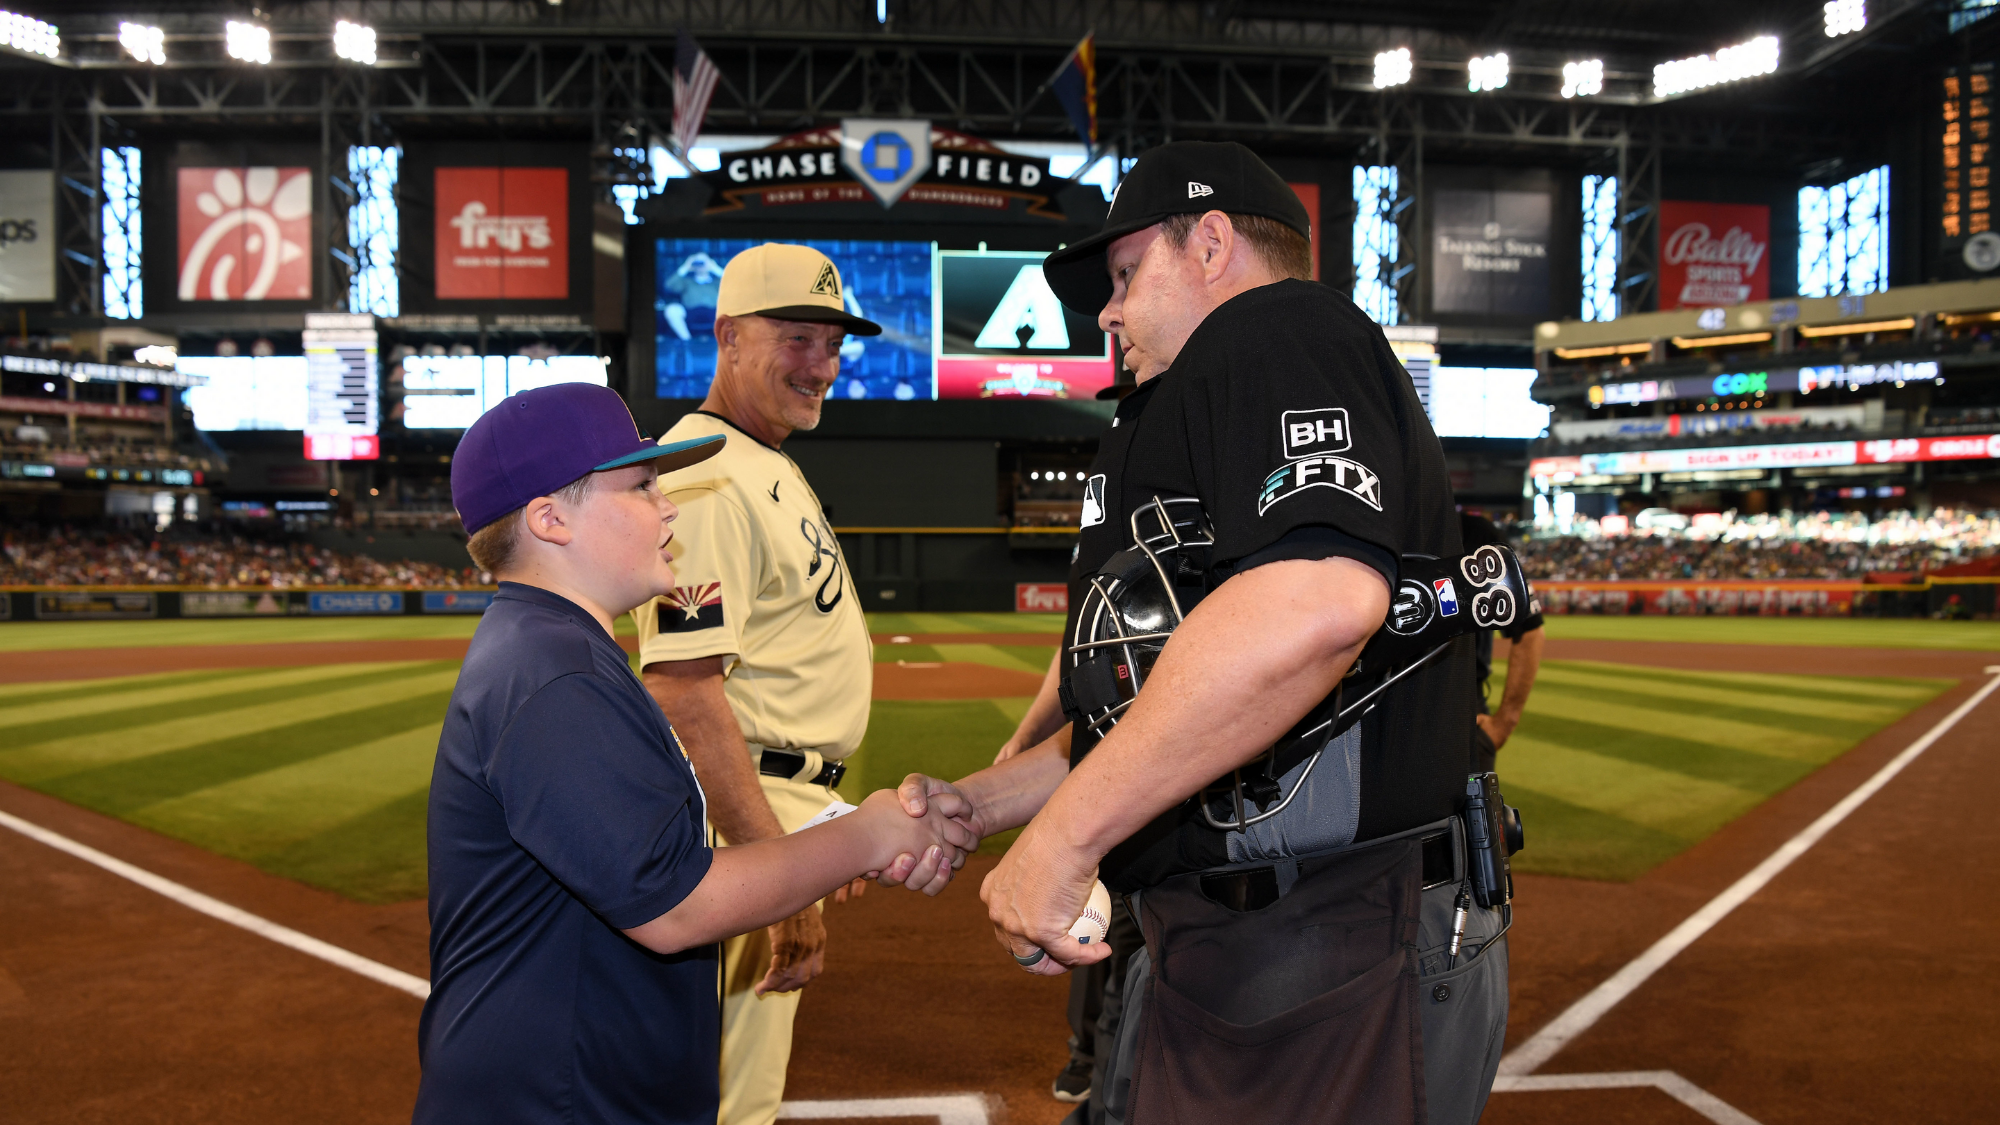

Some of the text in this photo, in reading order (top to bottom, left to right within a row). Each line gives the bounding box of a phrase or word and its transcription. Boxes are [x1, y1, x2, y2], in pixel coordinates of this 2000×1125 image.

[728, 152, 1041, 187] CHASE FIELD
[450, 201, 553, 252] fry's
[1664, 222, 1766, 278] Bally
[1712, 371, 1768, 397] COX
[1290, 419, 1343, 448] BH
[1295, 458, 1379, 505] FTX
